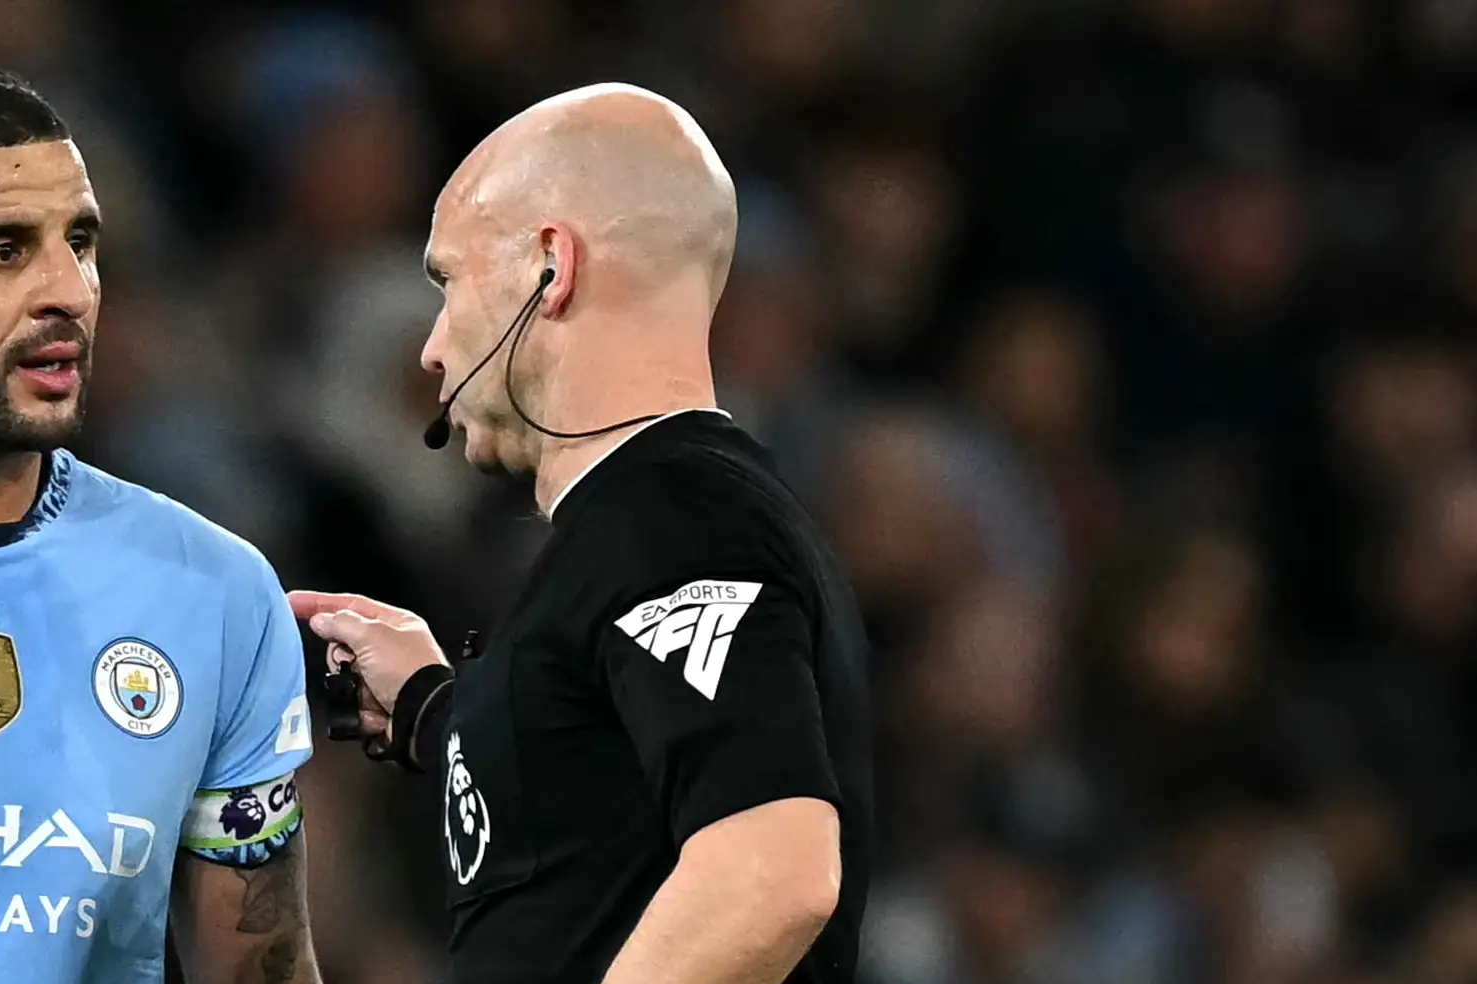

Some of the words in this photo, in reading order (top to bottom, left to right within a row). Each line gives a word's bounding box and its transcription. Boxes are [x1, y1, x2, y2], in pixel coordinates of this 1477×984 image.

[669, 584, 738, 608] SPORTS
[102, 645, 172, 680] MANCHESTER
[128, 720, 153, 733] CITY
